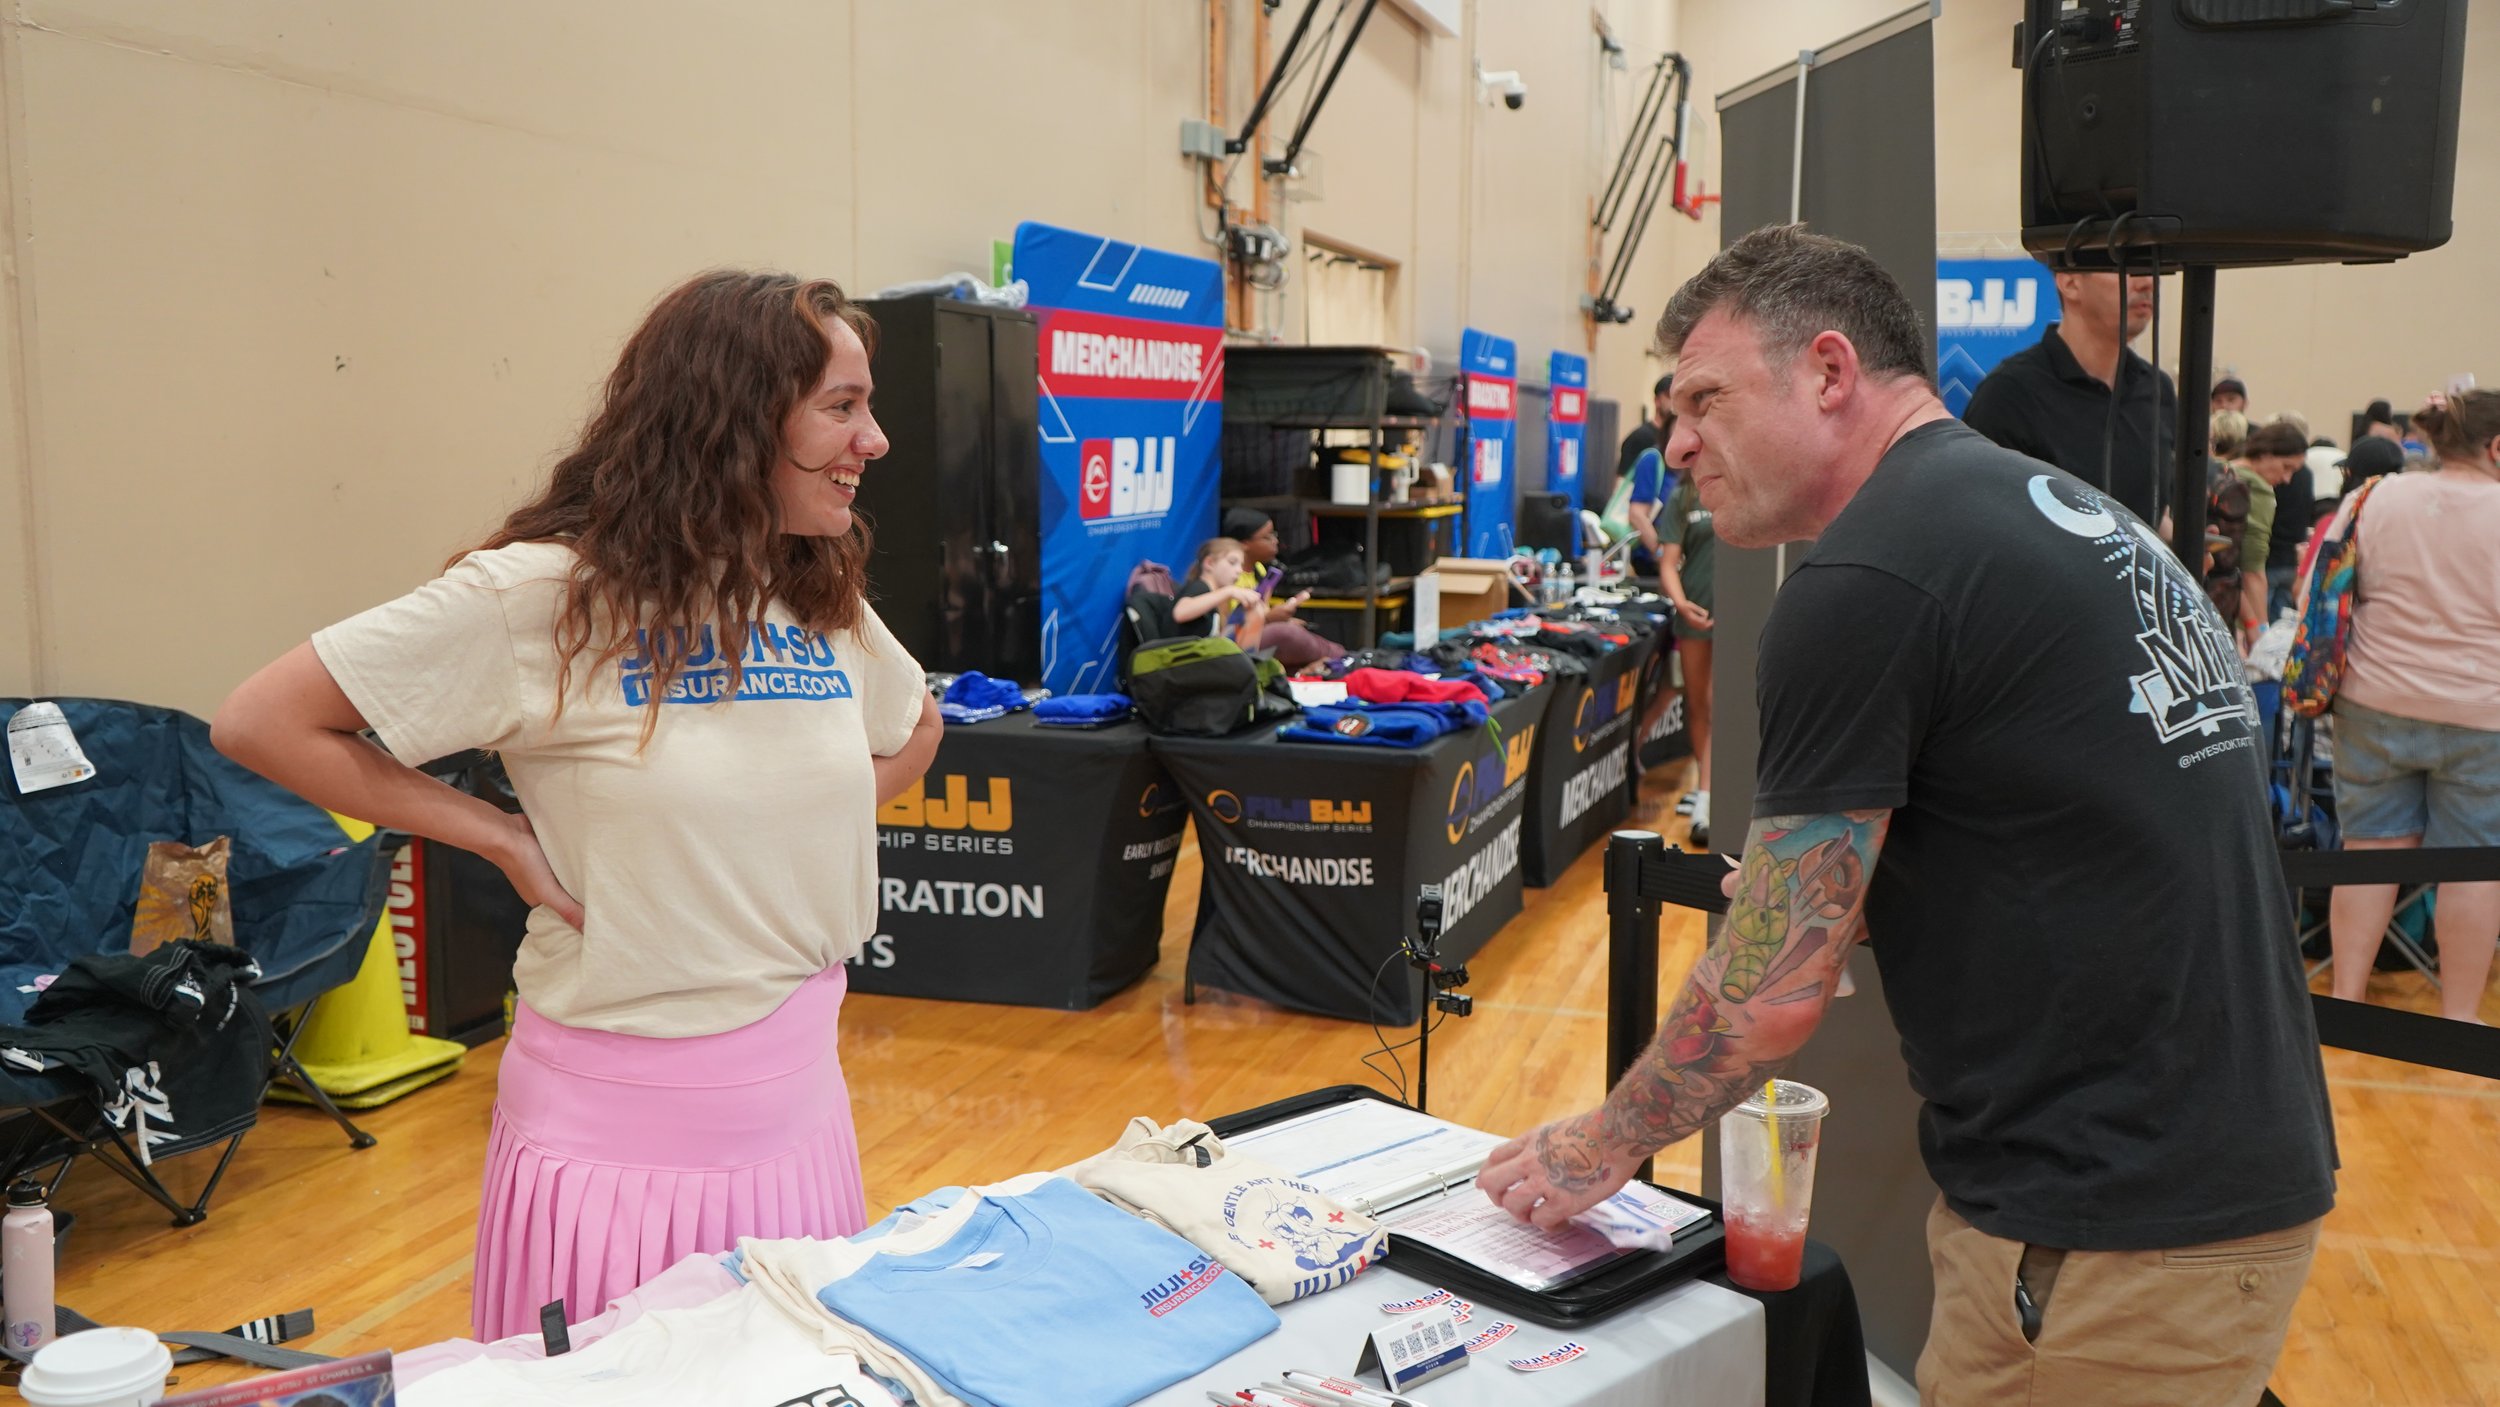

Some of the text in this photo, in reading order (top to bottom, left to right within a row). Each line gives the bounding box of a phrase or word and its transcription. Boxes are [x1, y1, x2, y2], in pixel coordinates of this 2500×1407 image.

[1051, 329, 1203, 383] MERCHANDISE
[1111, 436, 1176, 517] BJJ
[924, 833, 1014, 855] SERIES
